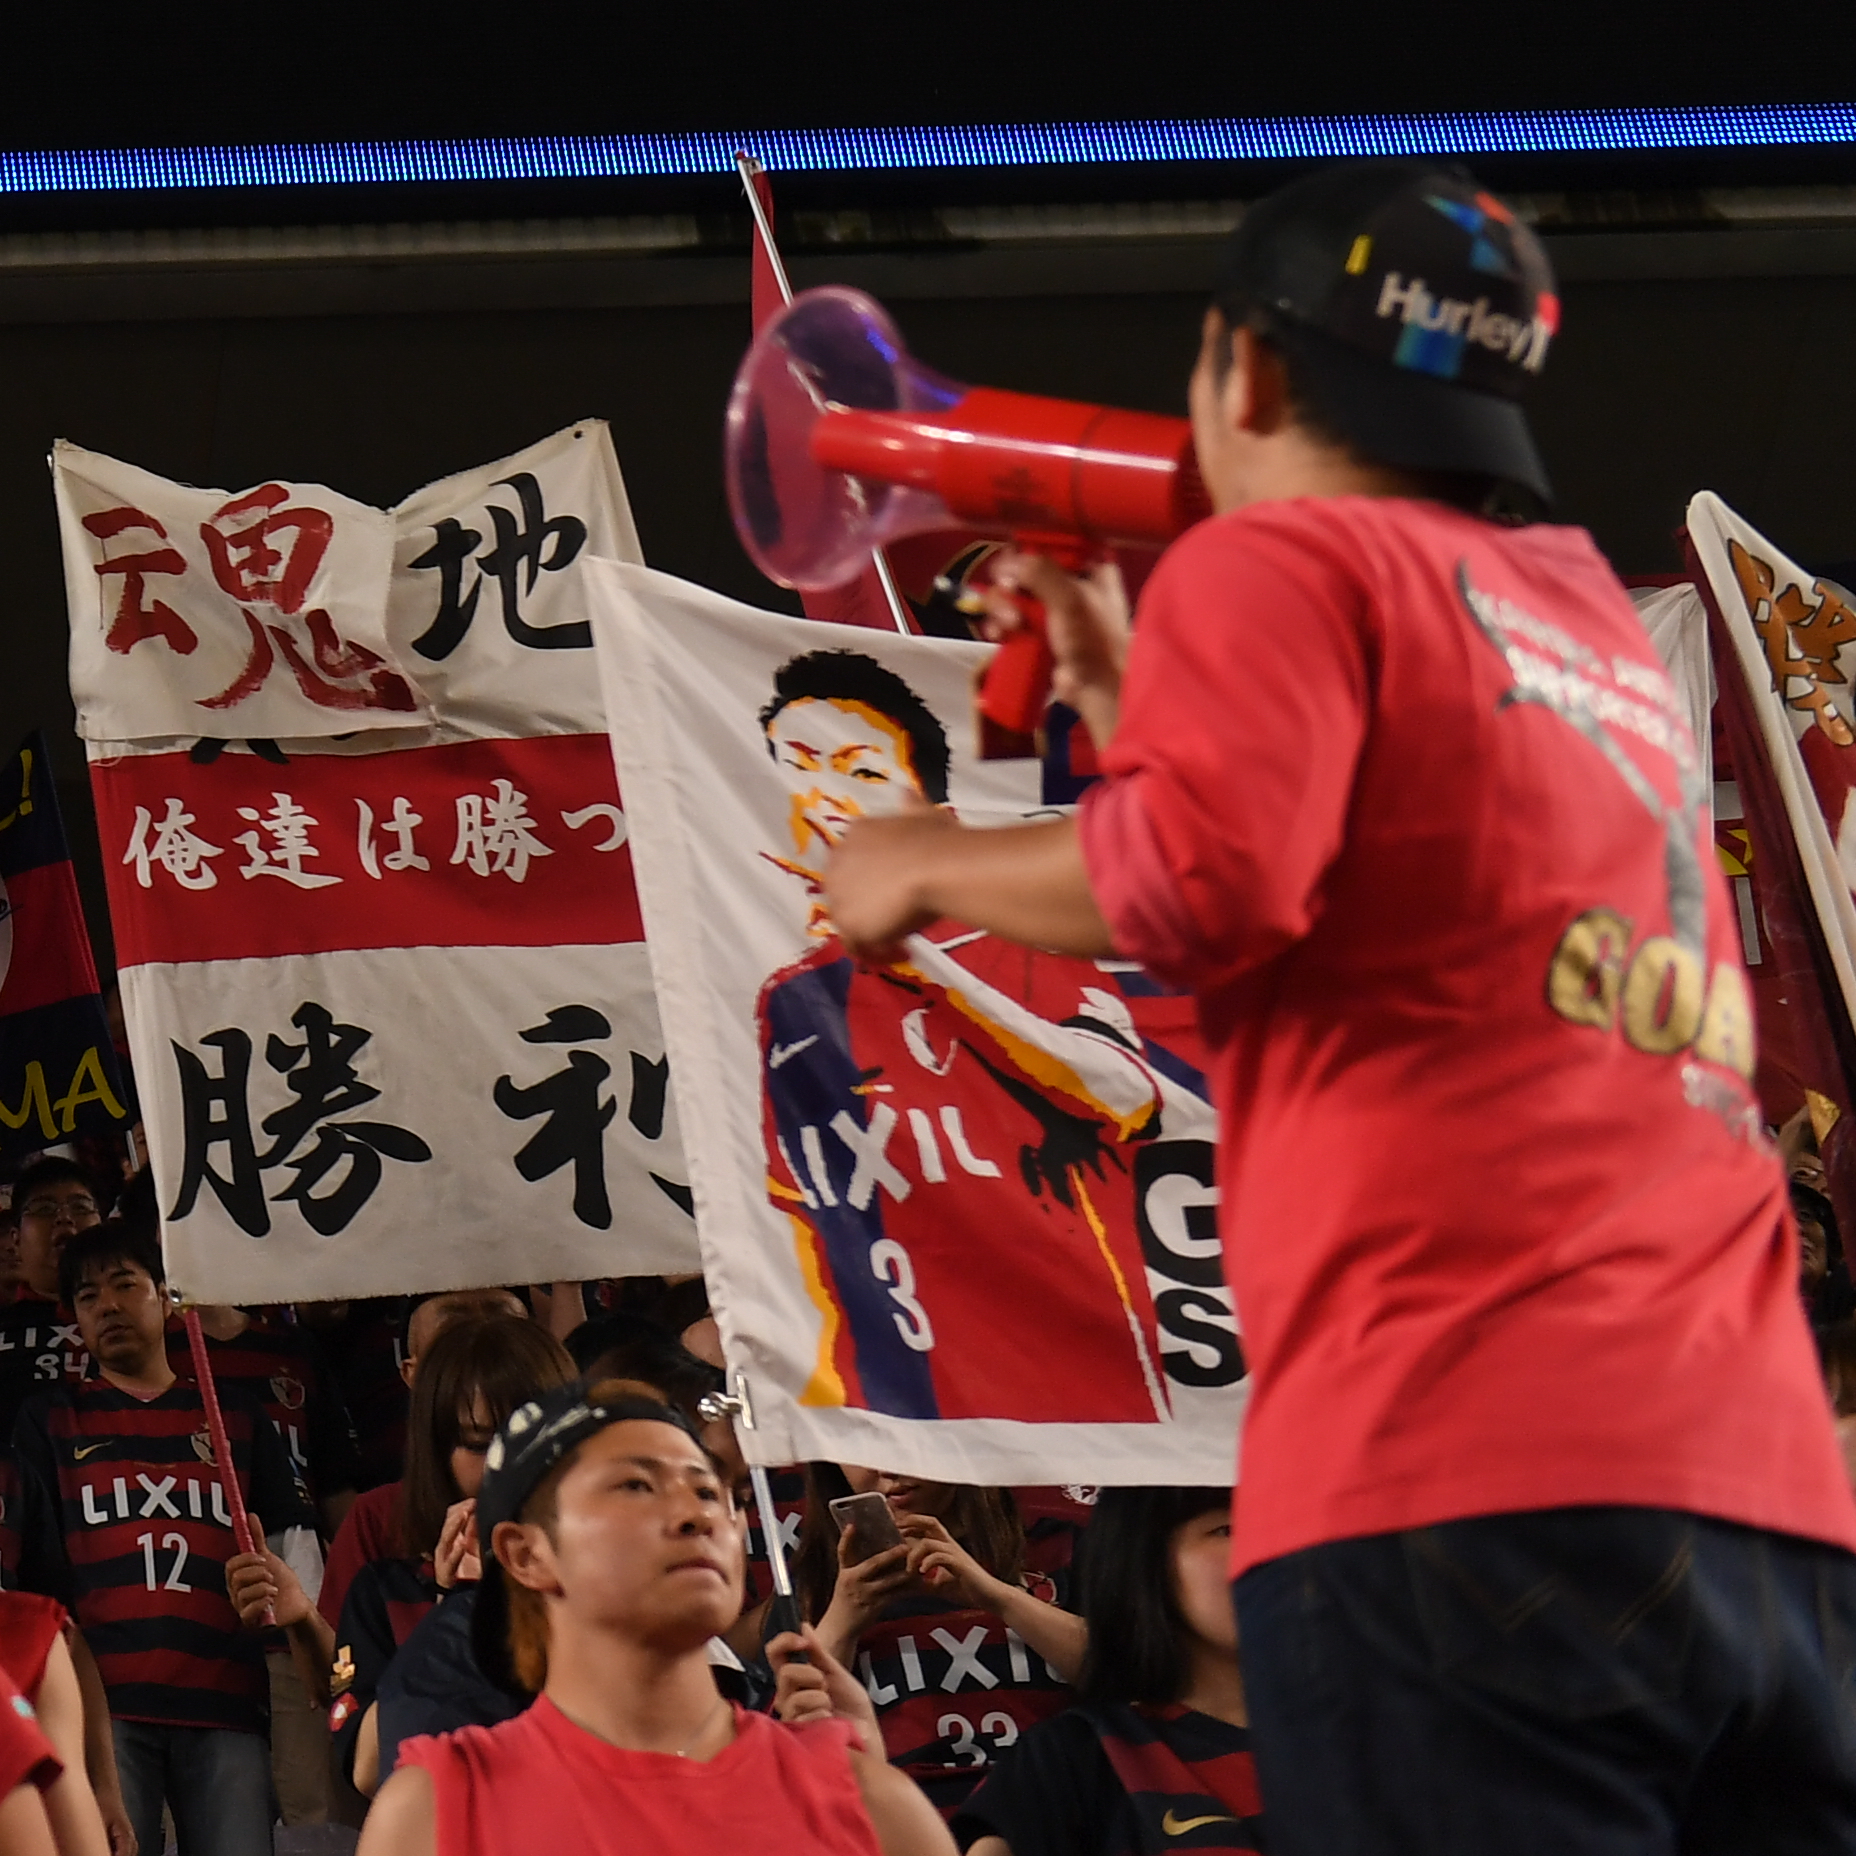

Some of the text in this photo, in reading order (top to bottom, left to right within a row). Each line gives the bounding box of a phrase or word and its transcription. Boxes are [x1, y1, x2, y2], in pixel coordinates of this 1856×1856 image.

[1376, 271, 1531, 363] Hurley
[408, 472, 594, 661] 地
[121, 779, 629, 891] 俺達は勝つ
[777, 1100, 1001, 1211] LIXIL
[869, 1237, 935, 1352] 3
[81, 1472, 234, 1528] LIXIL
[136, 1531, 192, 1594] 12
